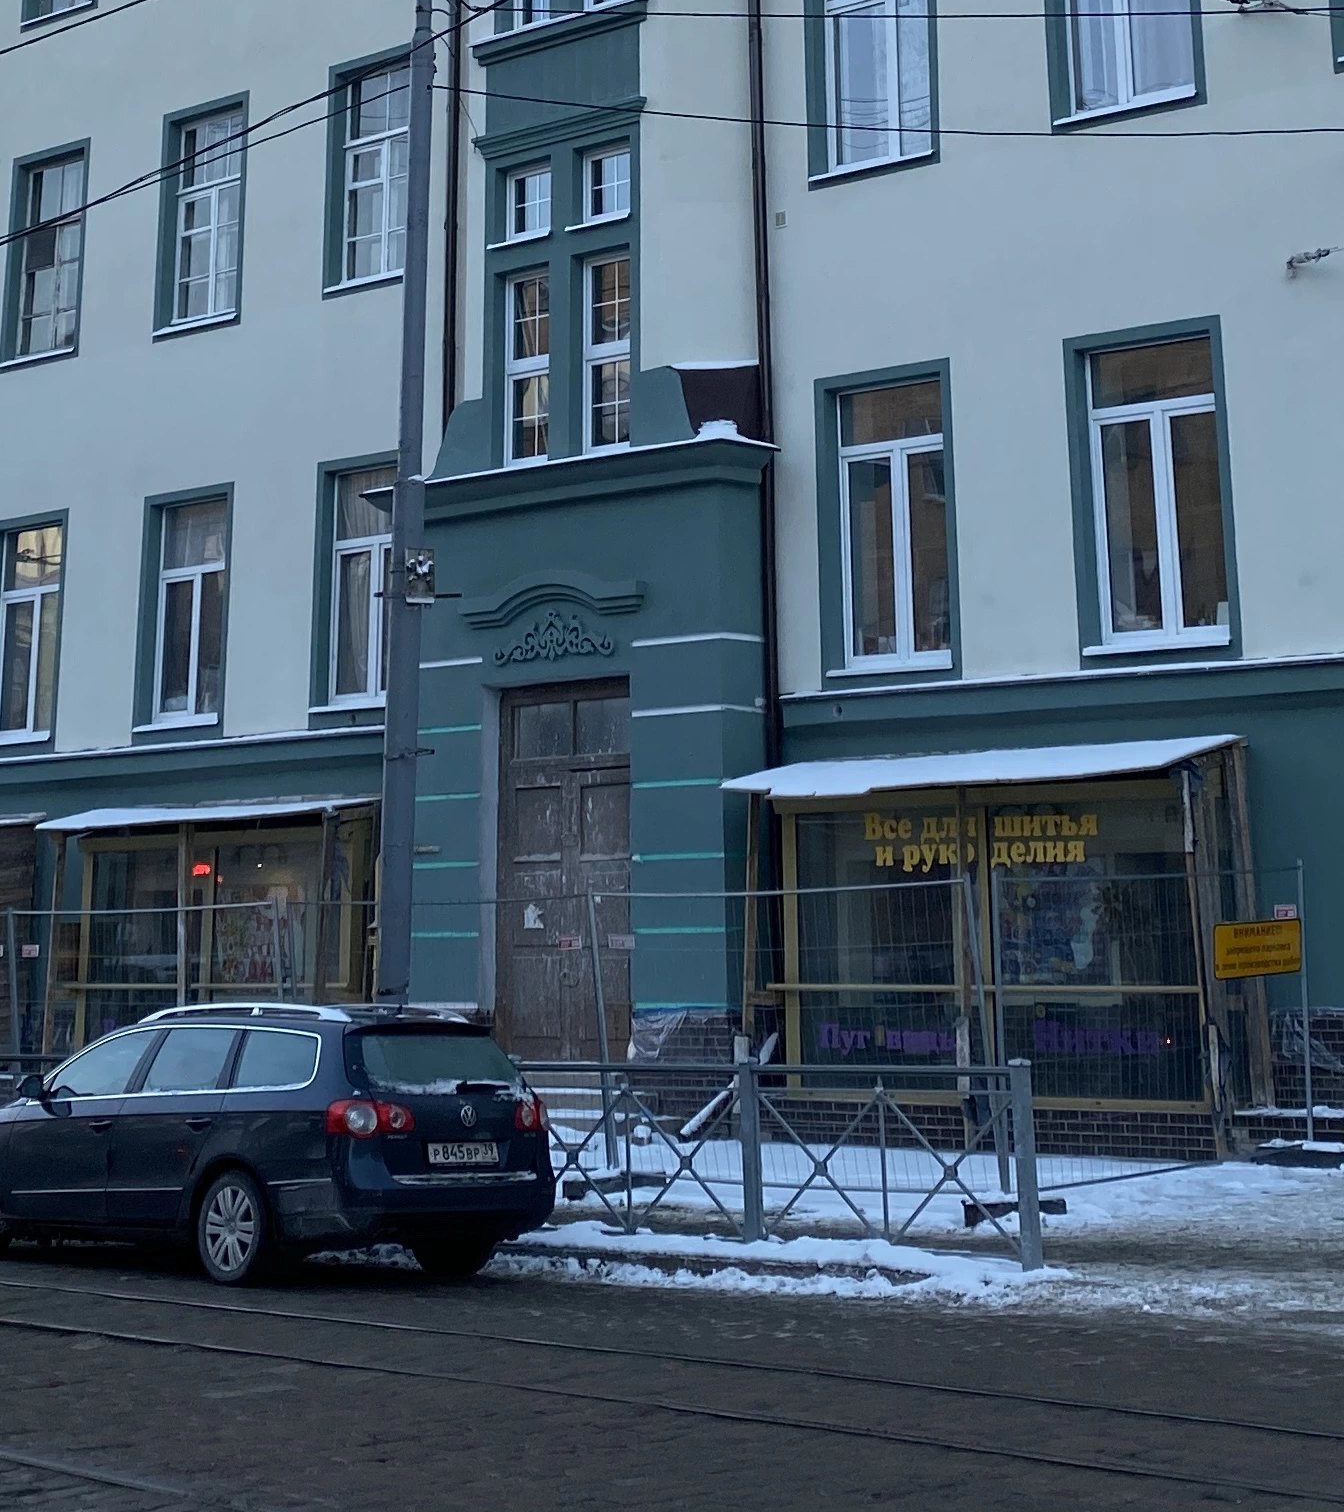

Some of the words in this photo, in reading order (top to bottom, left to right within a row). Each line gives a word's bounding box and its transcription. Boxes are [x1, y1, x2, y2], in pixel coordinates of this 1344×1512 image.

[864, 812, 912, 841] Все
[994, 813, 1098, 838] шитья
[875, 845, 894, 867] и
[483, 1144, 494, 1155] 39
